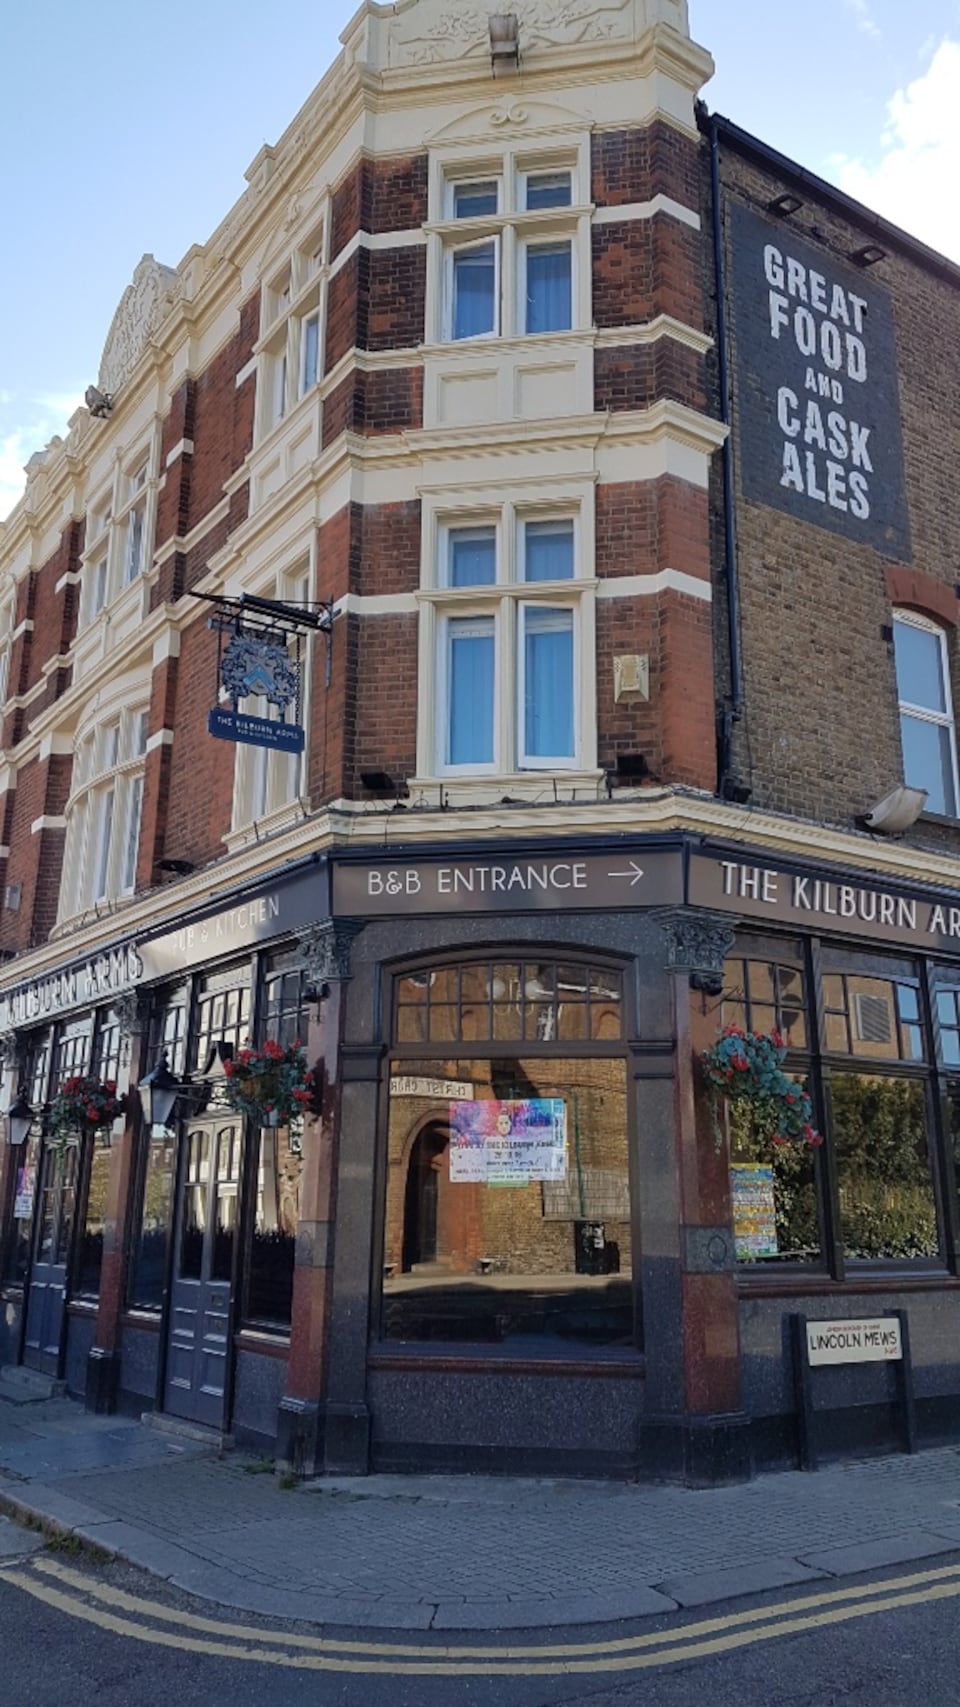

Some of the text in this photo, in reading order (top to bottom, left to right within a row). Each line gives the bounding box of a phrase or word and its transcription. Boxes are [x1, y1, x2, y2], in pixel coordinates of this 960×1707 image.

[764, 244, 867, 333] GREAT
[769, 290, 867, 383] FOOD
[804, 368, 843, 405] AND
[777, 387, 873, 473] CASK
[780, 442, 870, 520] ALES
[217, 716, 232, 727] THE
[368, 863, 587, 895] B&B ENTRANCE
[721, 861, 778, 903] THE
[794, 876, 916, 930] KILBURN
[216, 894, 279, 937] KITCHEN
[5, 941, 143, 1025] KILBURN ARMS
[810, 1331, 897, 1350] LINCOLN MEWS
